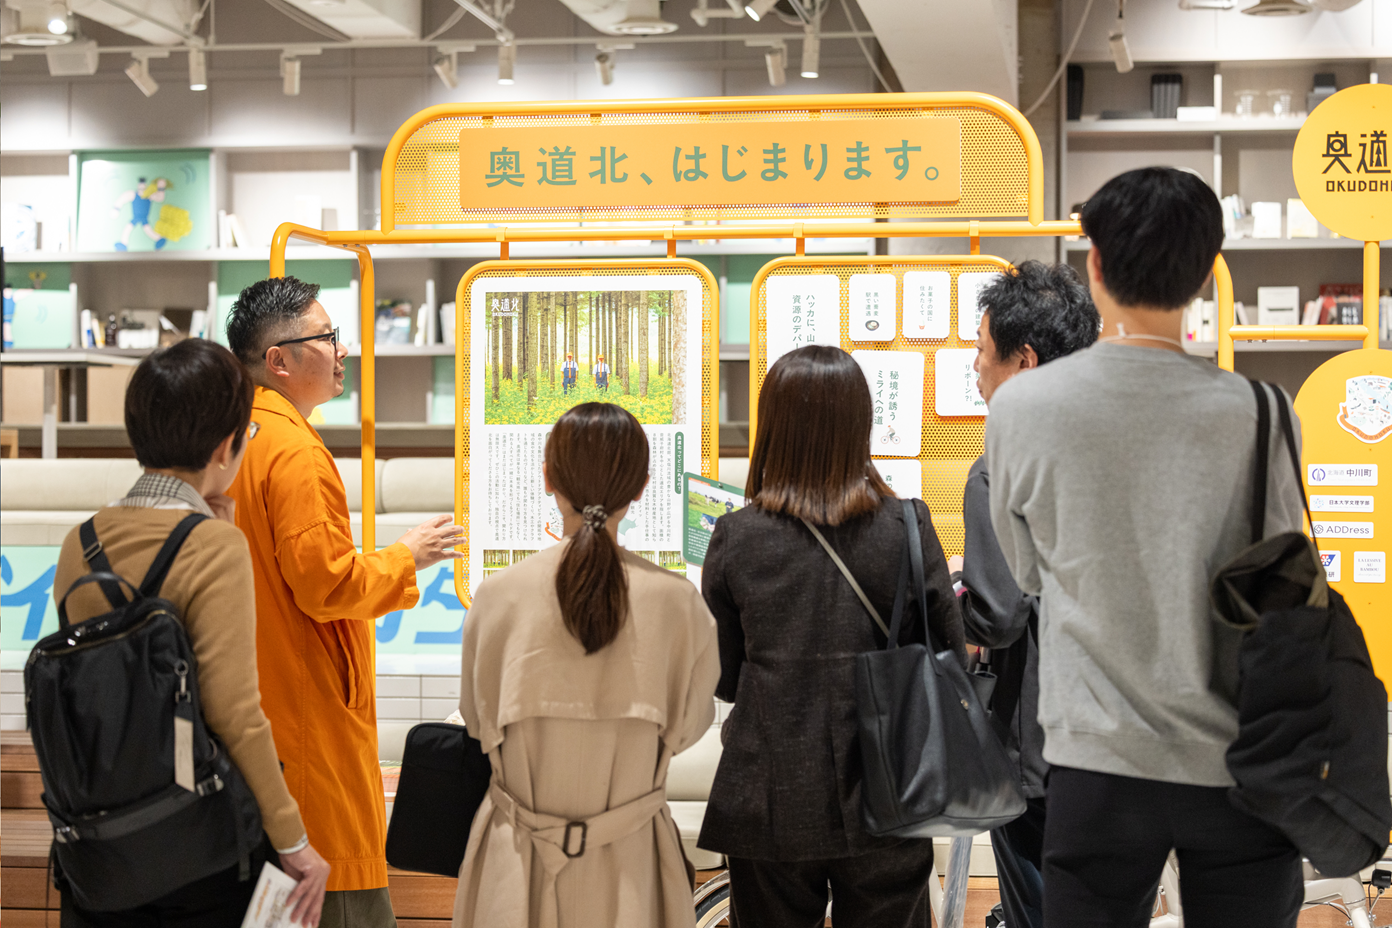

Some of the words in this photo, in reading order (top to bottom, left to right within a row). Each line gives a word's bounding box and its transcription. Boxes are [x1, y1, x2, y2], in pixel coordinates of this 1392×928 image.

[484, 138, 940, 188] 奥道北、はじまります。
[1326, 180, 1392, 192] OKUDOH
[806, 294, 815, 343] ハッカに、山
[874, 370, 884, 425] ミライへの道
[889, 370, 899, 422] 秘境が誘う
[1346, 468, 1372, 477] 中川町
[1326, 525, 1370, 534] ADDress
